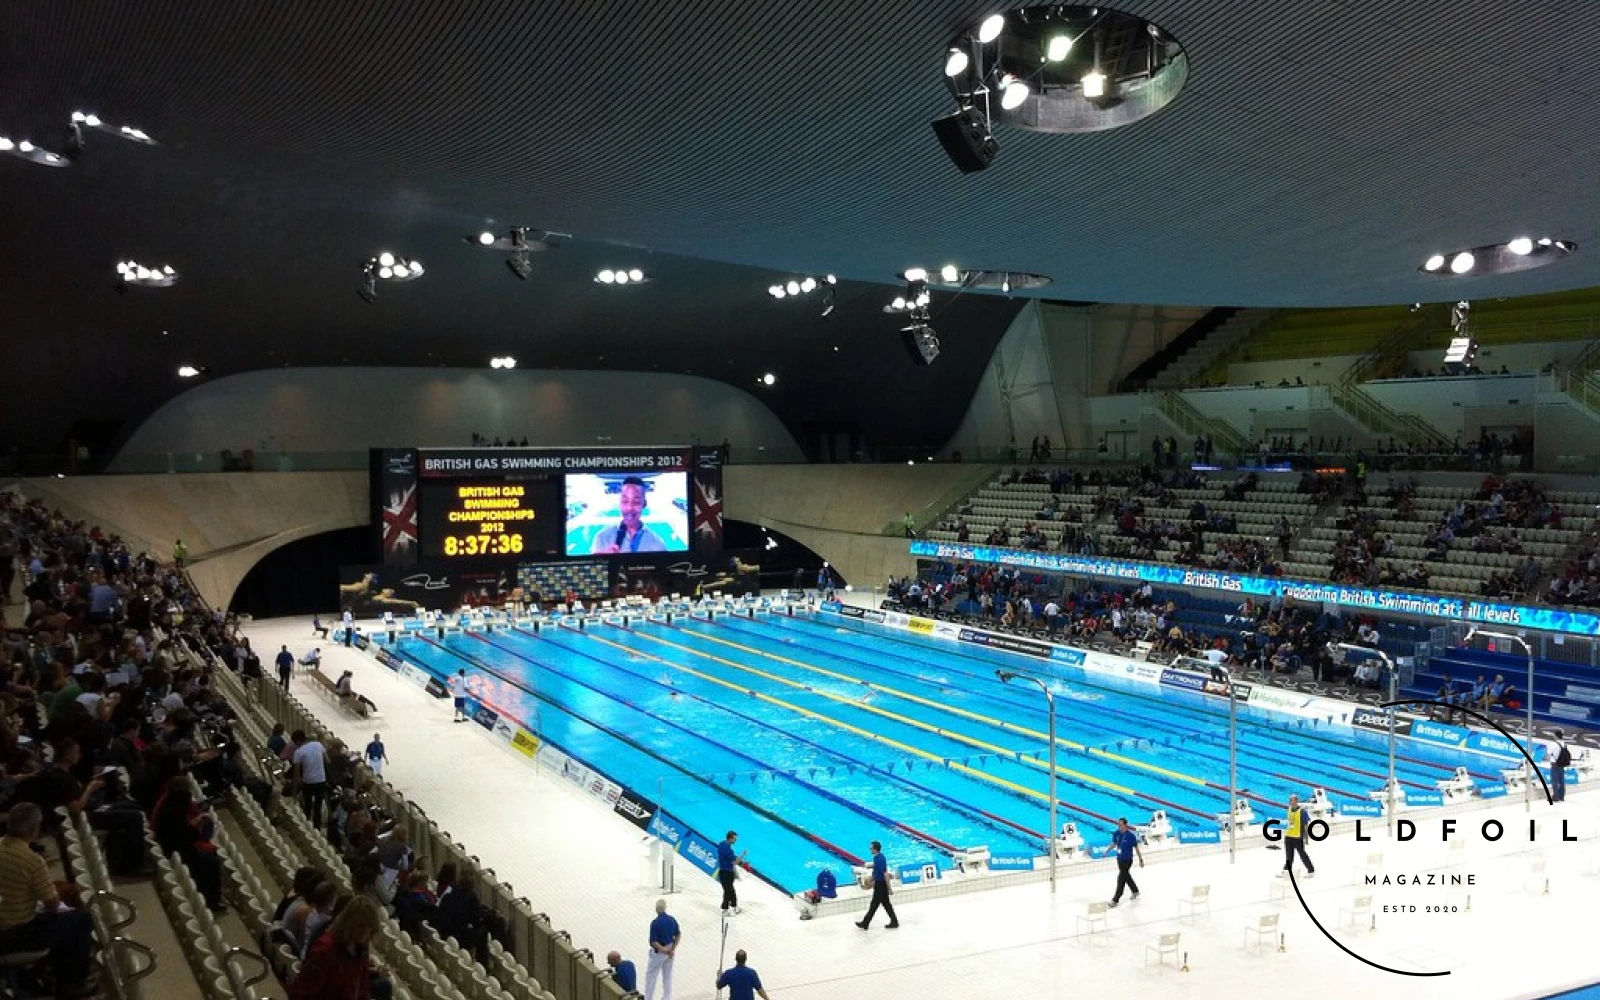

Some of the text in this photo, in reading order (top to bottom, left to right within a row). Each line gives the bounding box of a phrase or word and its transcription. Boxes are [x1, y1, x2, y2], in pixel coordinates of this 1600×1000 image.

[425, 459, 471, 470] BRITISH
[474, 459, 498, 469] GAS
[502, 458, 561, 468] SWIMMING
[564, 456, 654, 468] CHAMPIONSHIPS
[657, 456, 682, 466] 2012
[459, 486, 525, 497] BRITISH GAS
[464, 498, 520, 509] SWIMMING
[449, 509, 535, 522] CHAMPIONSHIPS
[481, 522, 505, 532] 2012
[444, 533, 523, 556] 8:37:36
[961, 548, 975, 560] Gas
[1185, 571, 1242, 591] British Gas
[1340, 589, 1376, 605] British
[1379, 593, 1439, 615] Swimming
[1443, 603, 1455, 614] at
[1484, 605, 1520, 623] levels
[1416, 724, 1459, 740] British Gas
[1480, 736, 1508, 750] British
[1343, 804, 1379, 813] British Gas
[1181, 831, 1203, 839] British
[992, 857, 1031, 865] British Gas
